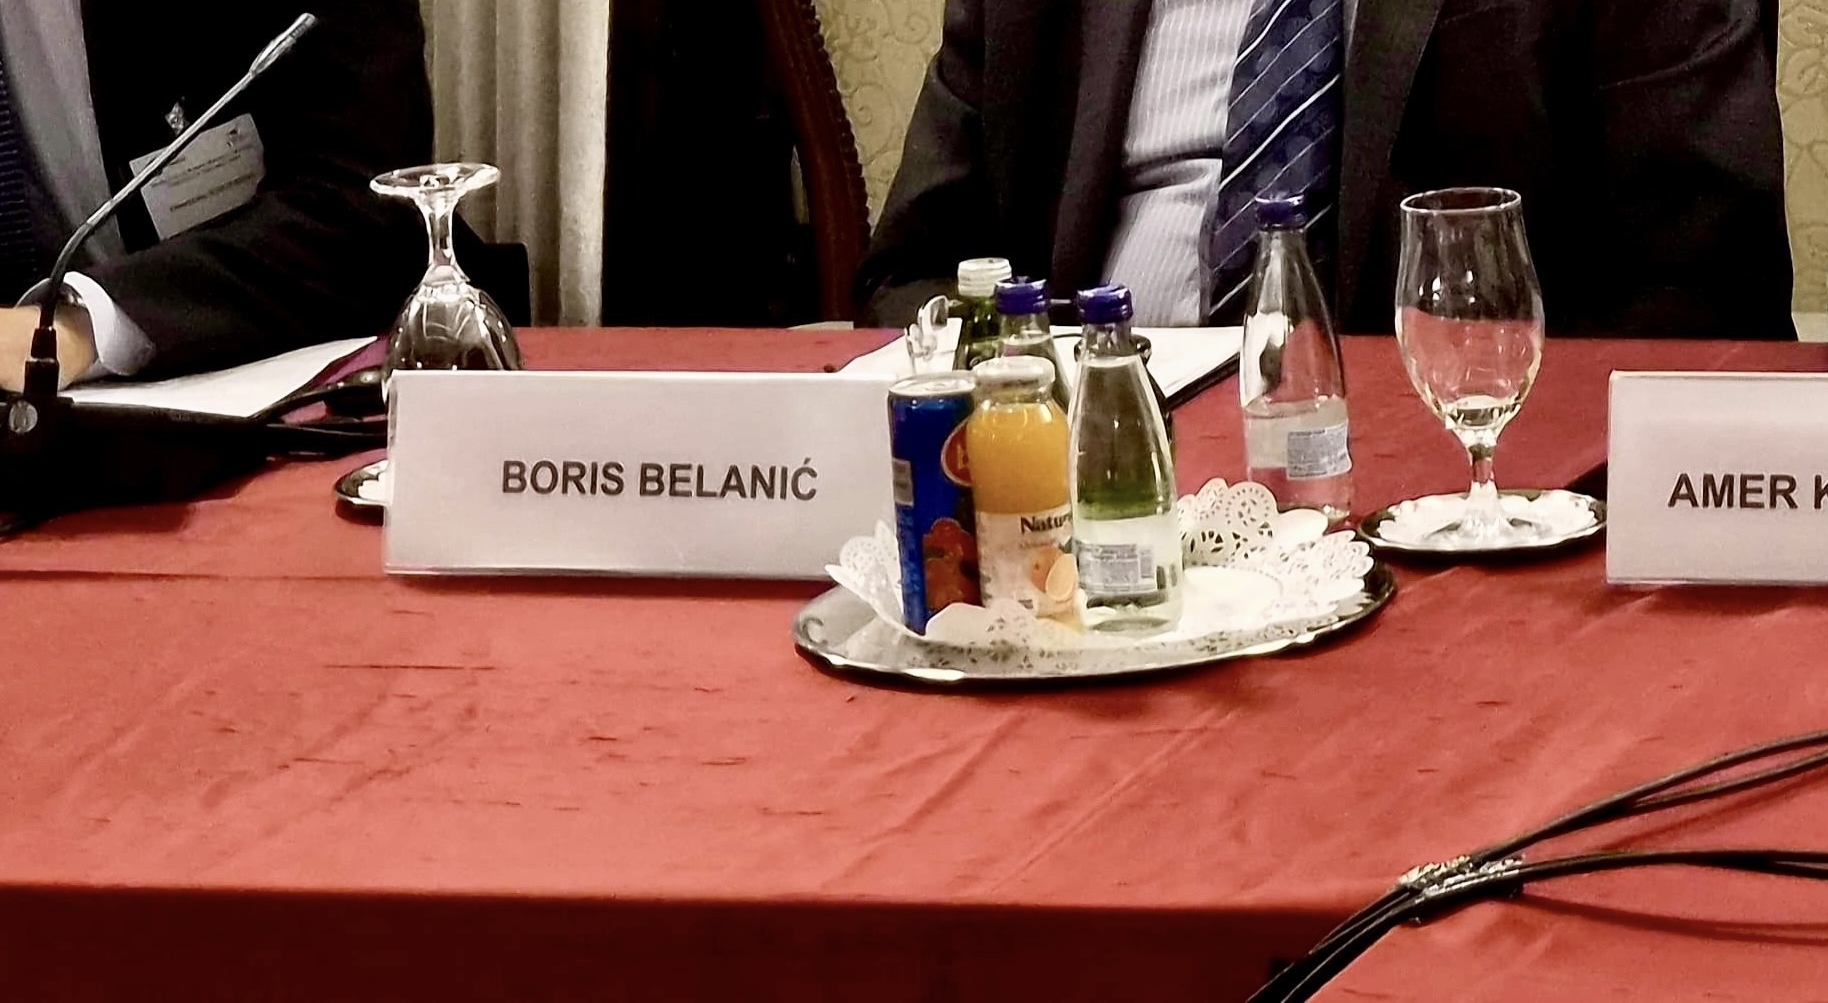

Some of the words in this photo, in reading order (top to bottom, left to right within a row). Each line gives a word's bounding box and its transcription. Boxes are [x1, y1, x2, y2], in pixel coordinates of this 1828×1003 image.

[502, 459, 625, 496] BORIS
[639, 457, 818, 501] BELANIĆ
[1667, 473, 1798, 510] AMER
